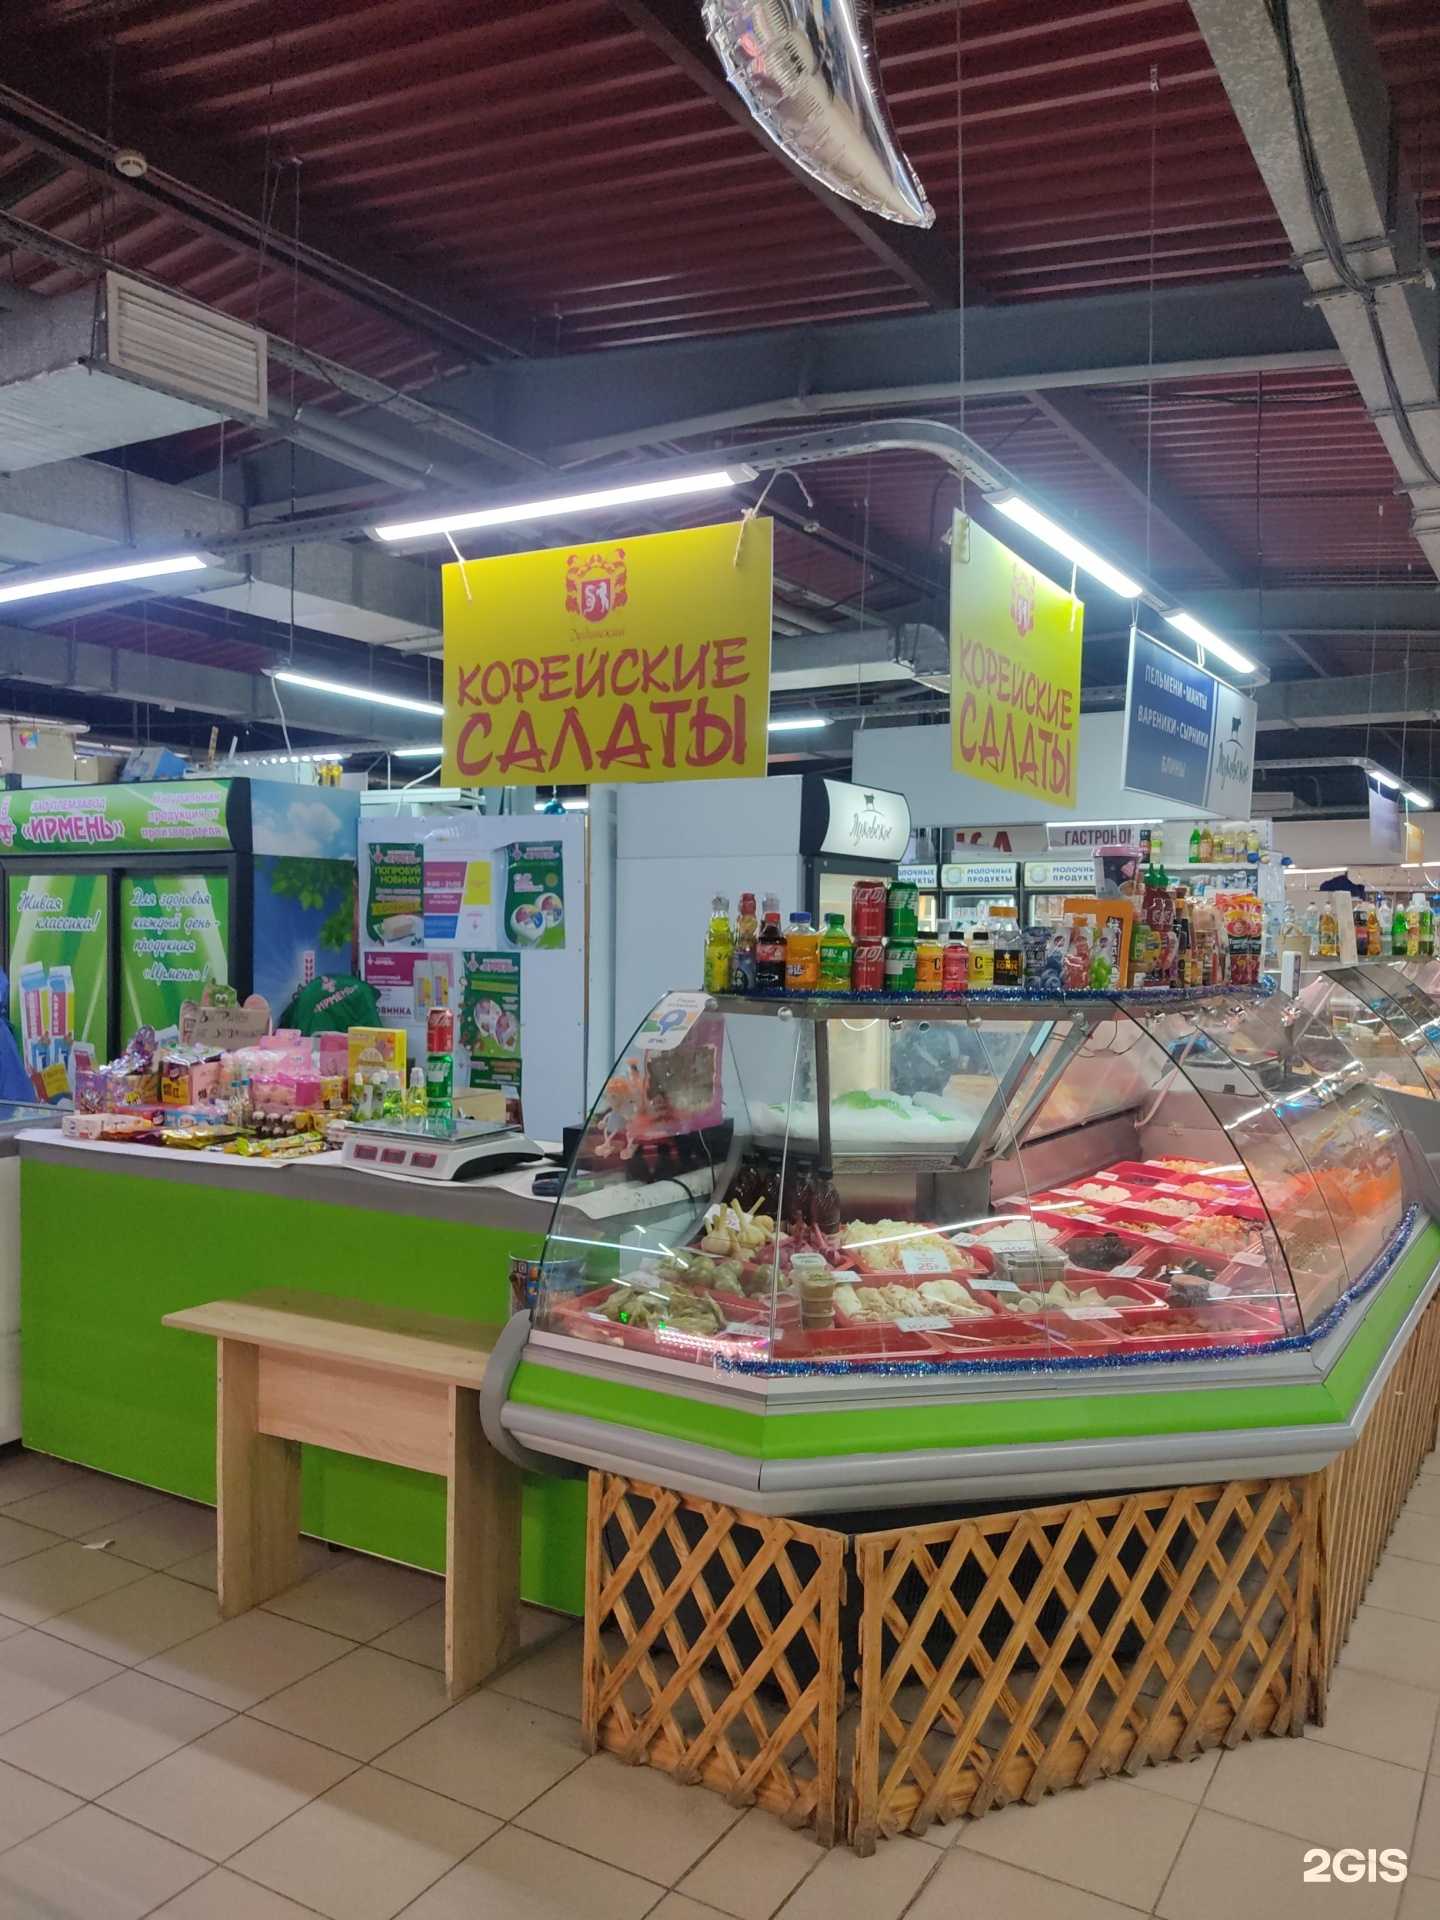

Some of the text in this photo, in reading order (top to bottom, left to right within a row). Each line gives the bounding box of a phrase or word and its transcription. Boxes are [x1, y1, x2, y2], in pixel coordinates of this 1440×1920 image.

[458, 637, 750, 706] КОРЕЙСКИЕ
[959, 632, 1073, 731] КОРЕЙСКИЕ
[456, 694, 749, 776] САЛАТЫ
[959, 691, 1071, 797] САЛАТЫ
[967, 875, 1013, 883] ПРОДУКТЫ
[1052, 874, 1094, 882] ПРОДУКТ
[18, 891, 63, 912] Живая
[376, 1007, 412, 1016] ОВИНКА
